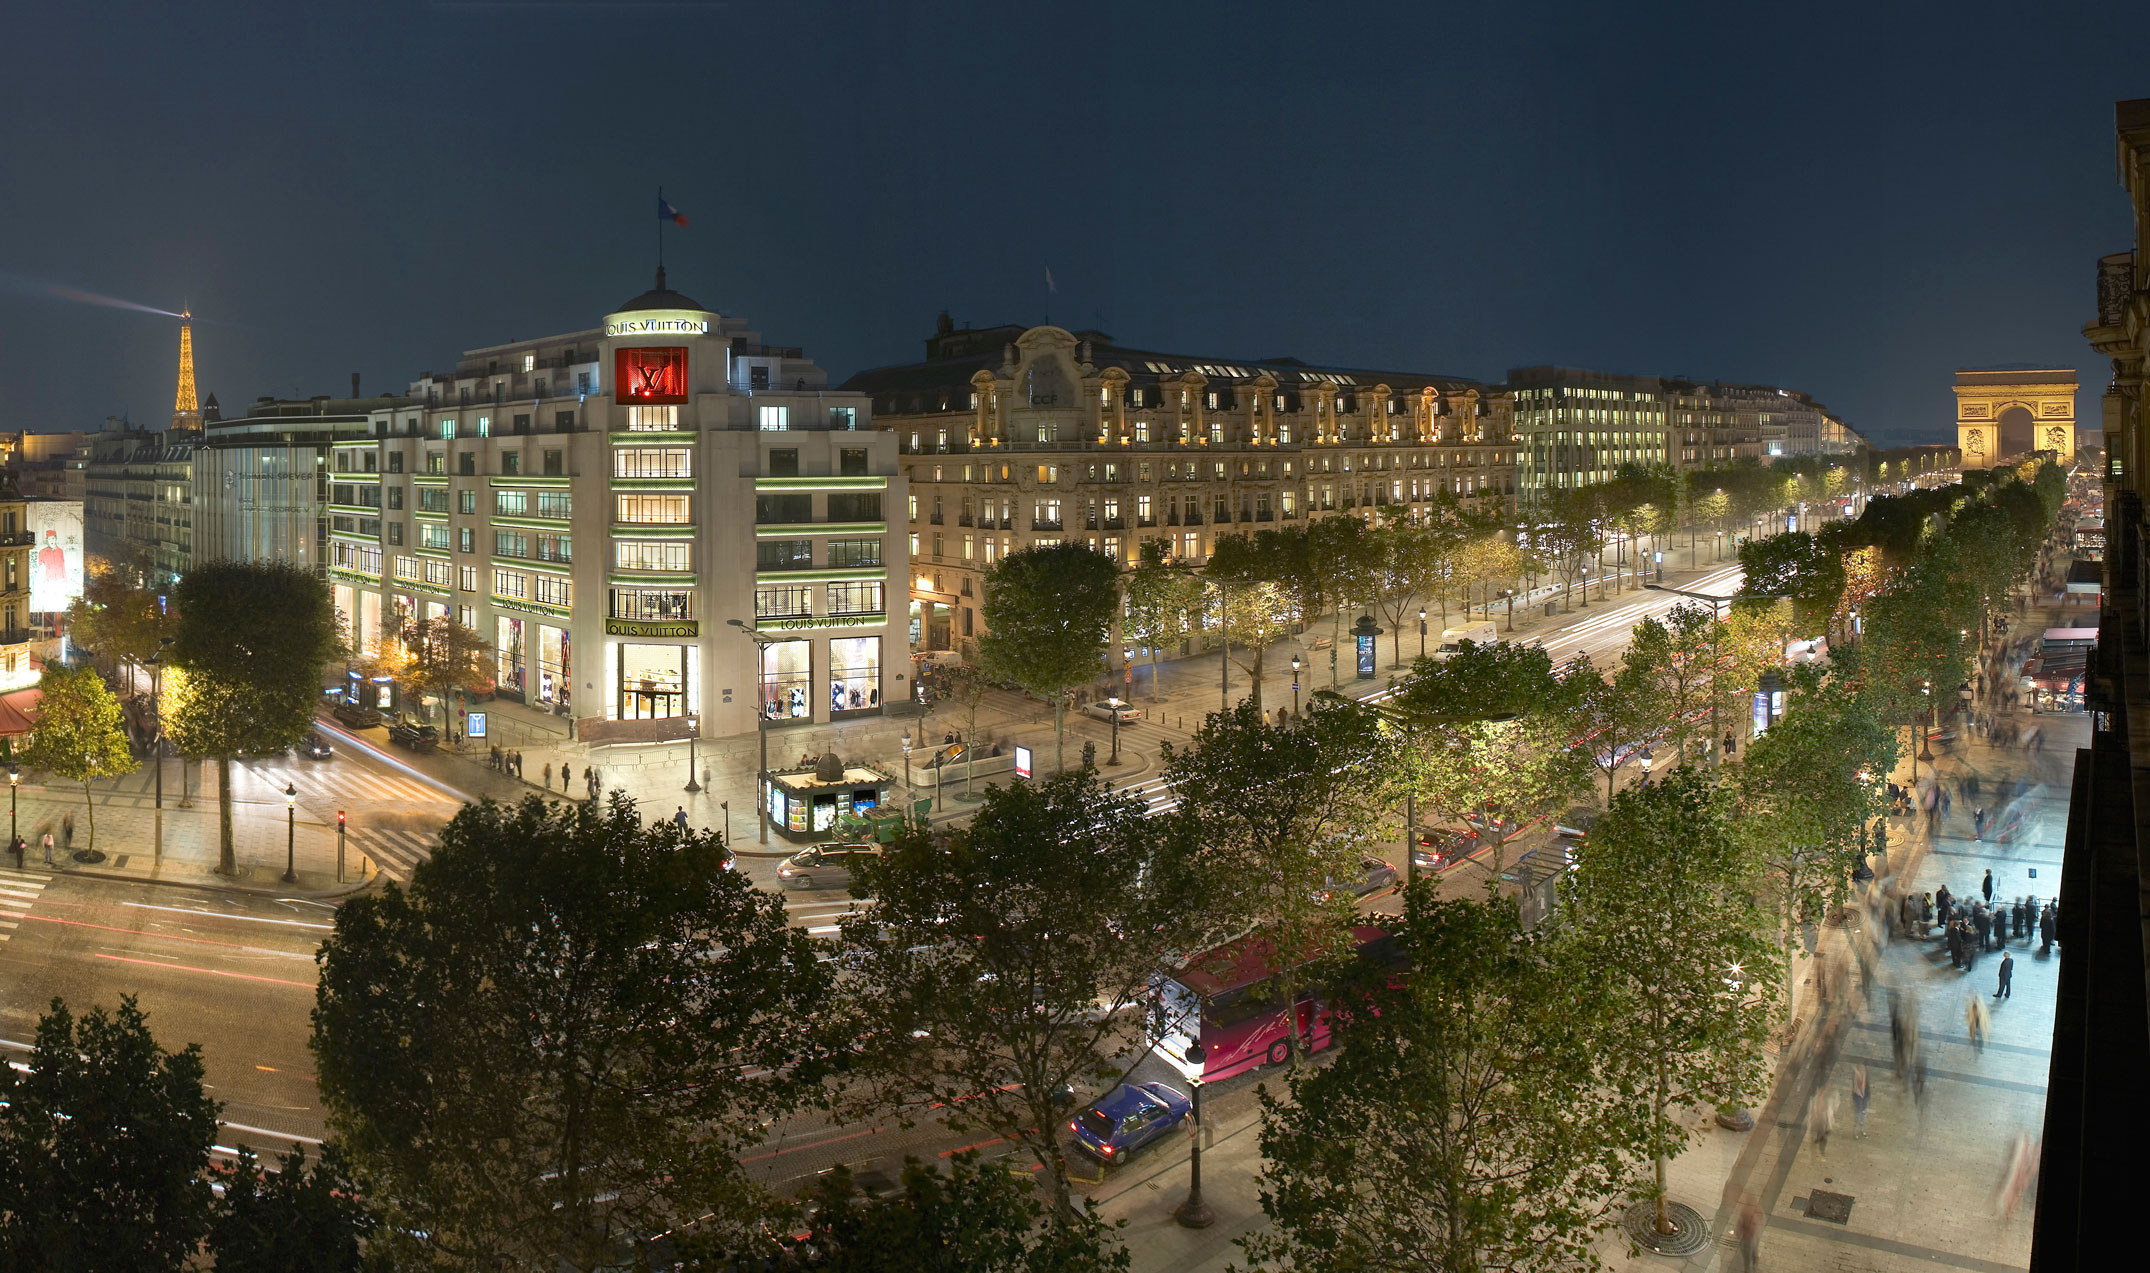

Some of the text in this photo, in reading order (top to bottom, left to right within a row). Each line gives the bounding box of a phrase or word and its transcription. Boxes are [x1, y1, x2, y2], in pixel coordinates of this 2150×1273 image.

[640, 321, 704, 332] VUITTON
[1032, 395, 1058, 405] CCF
[277, 471, 314, 481] SPEYER
[400, 580, 440, 595] LOUIS VUITTON
[502, 599, 555, 616] LOUIS VUITTON
[781, 617, 865, 630] LOUIS VUITTON
[640, 626, 697, 637] VUITTON
